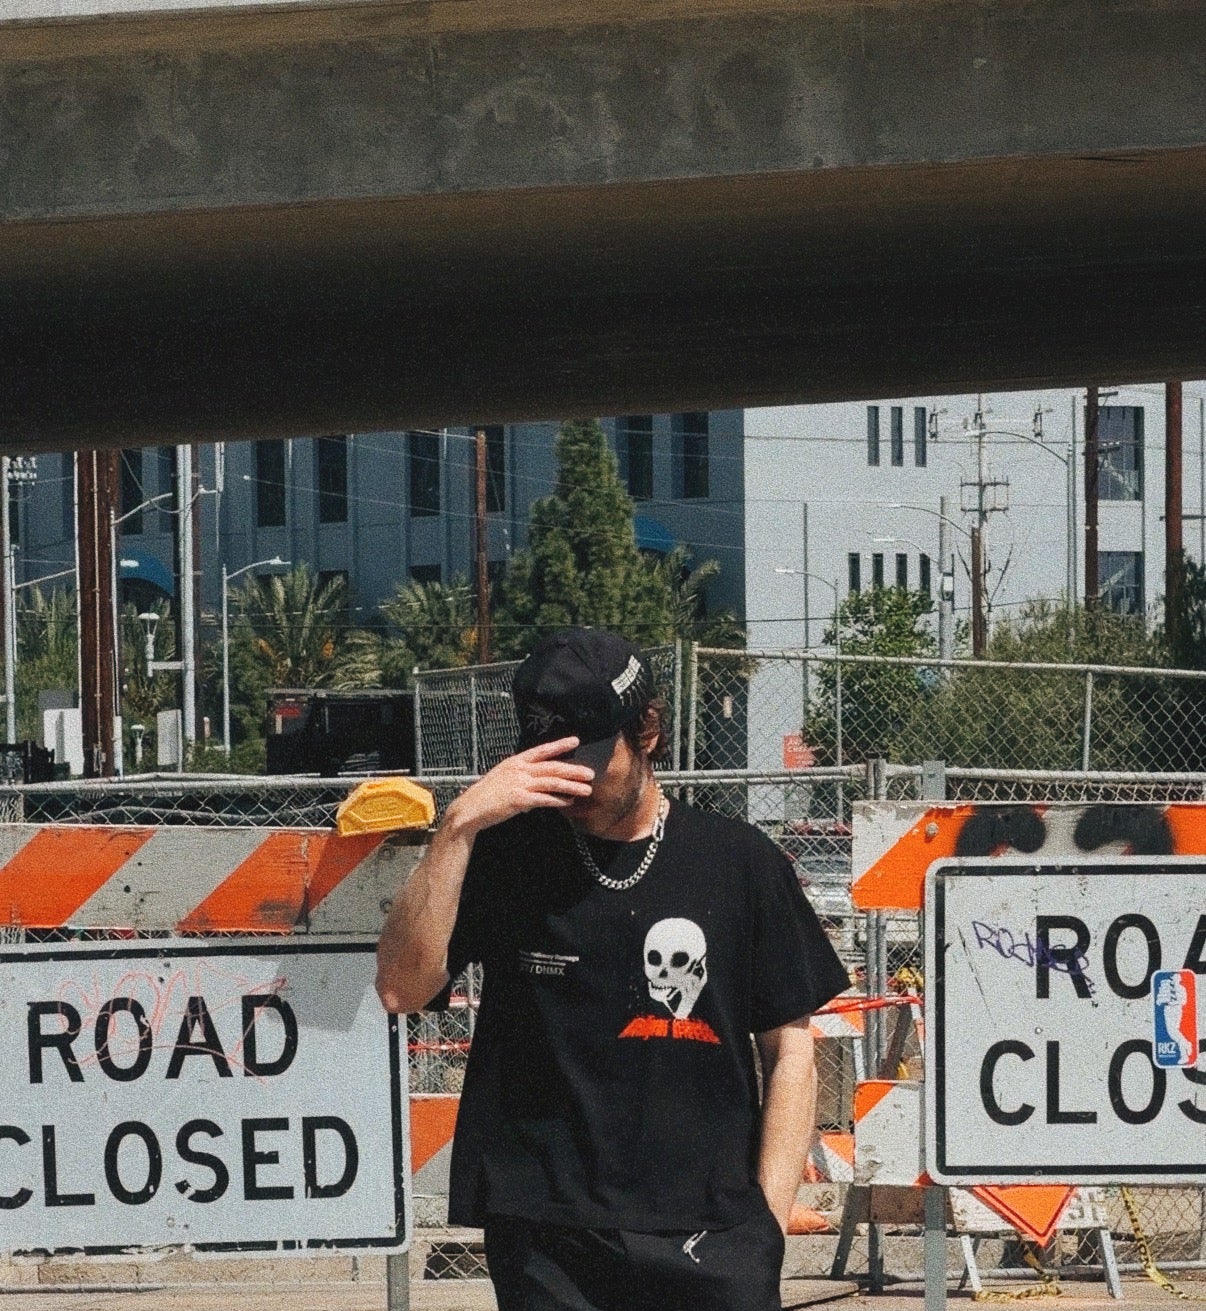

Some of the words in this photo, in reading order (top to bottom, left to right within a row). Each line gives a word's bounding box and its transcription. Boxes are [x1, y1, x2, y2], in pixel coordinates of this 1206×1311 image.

[28, 993, 298, 1083] ROAD
[1158, 1042, 1176, 1055] RKZ
[0, 1116, 359, 1209] CLOSED
